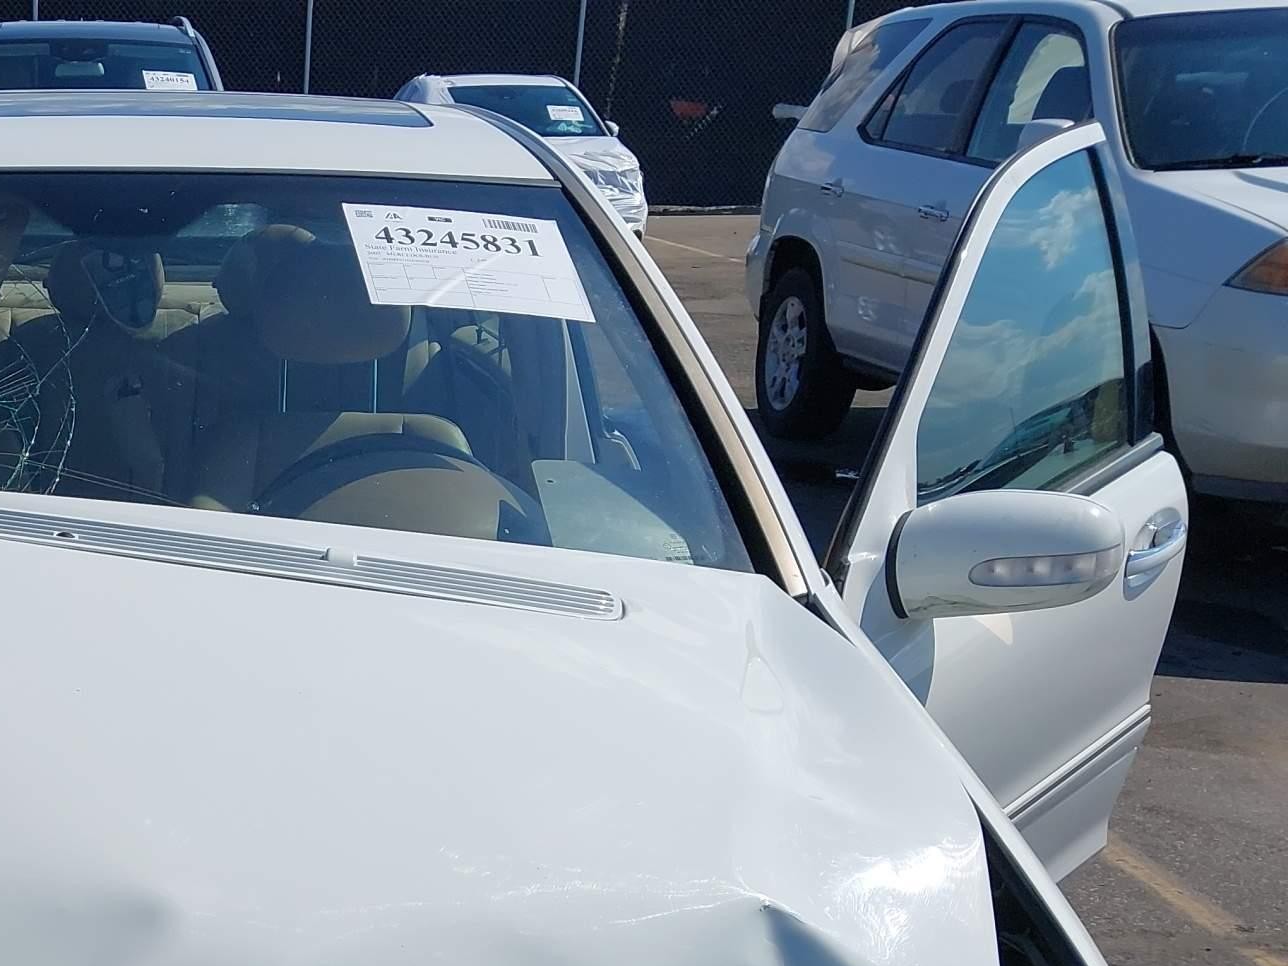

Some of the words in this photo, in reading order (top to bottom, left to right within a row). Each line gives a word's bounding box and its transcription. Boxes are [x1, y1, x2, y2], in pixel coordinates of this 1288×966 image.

[364, 243, 387, 251] State
[389, 245, 413, 253] Farm
[415, 246, 457, 256] Insurance
[374, 226, 543, 257] 43245831
